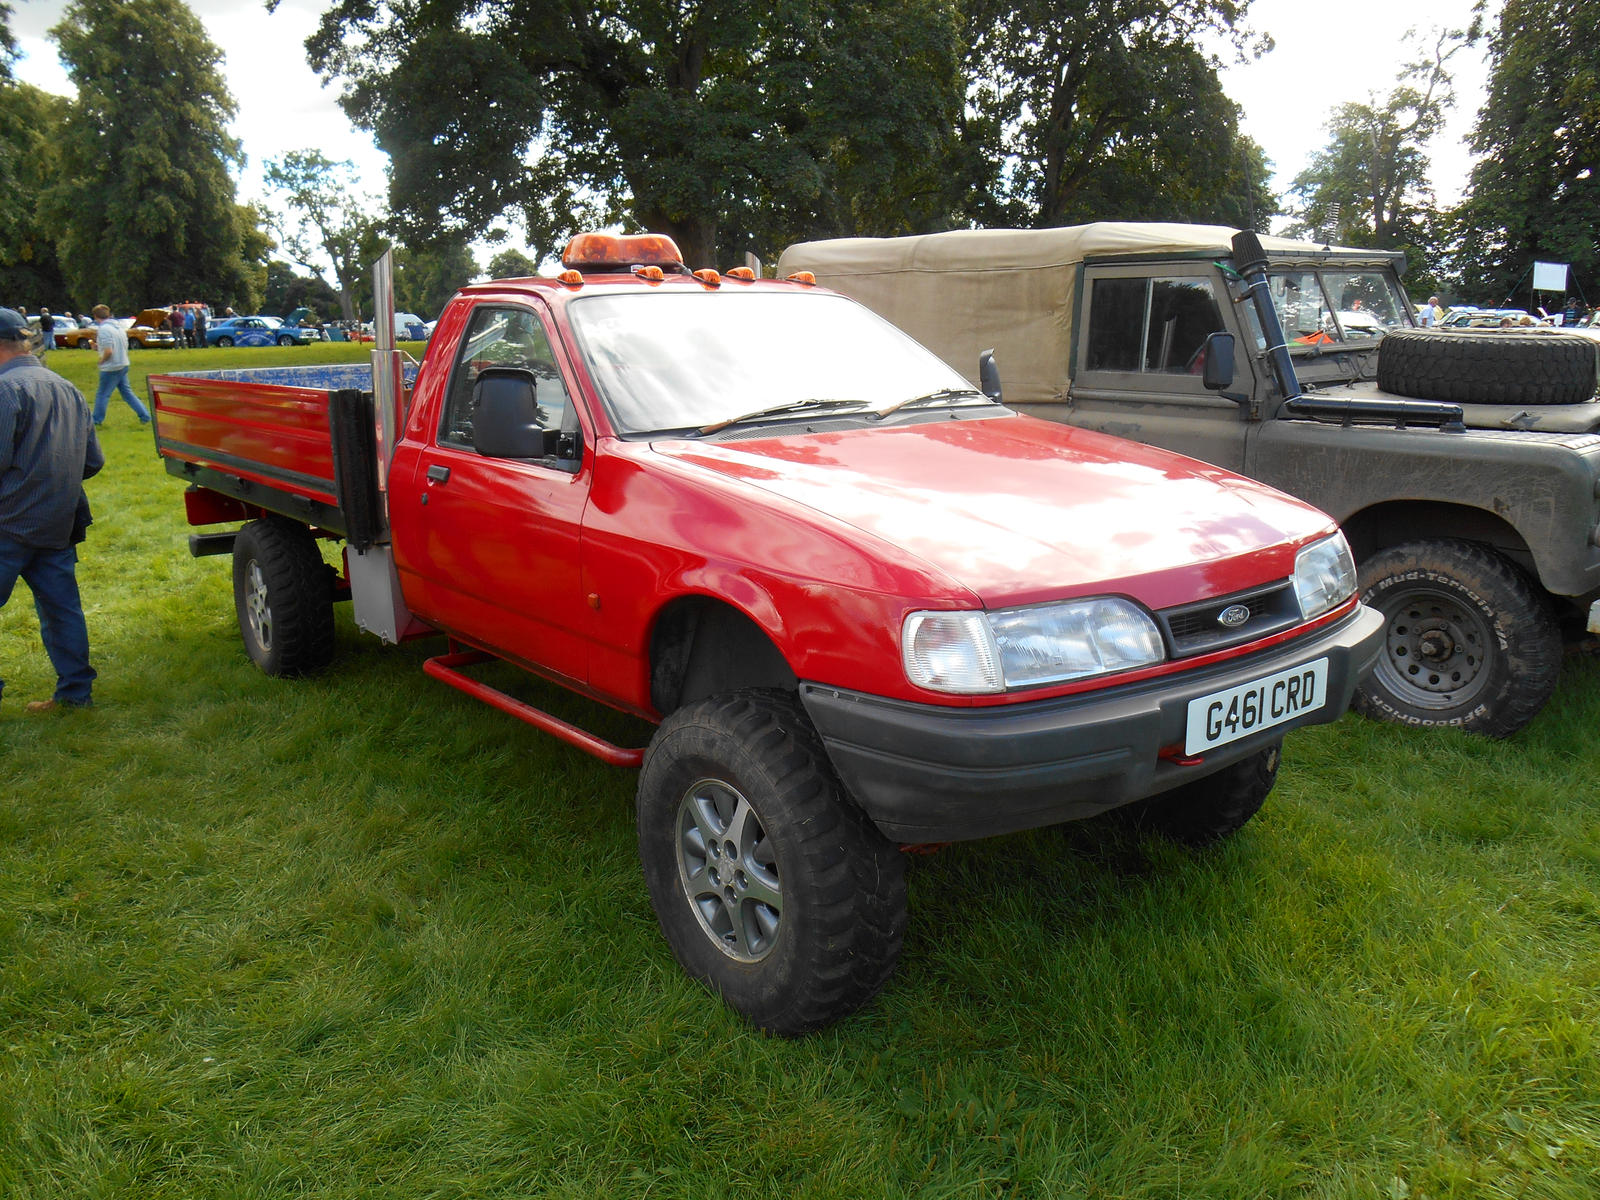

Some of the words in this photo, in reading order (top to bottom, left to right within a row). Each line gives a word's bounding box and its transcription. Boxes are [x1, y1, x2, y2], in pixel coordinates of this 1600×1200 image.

[1379, 571, 1495, 618] Mud-Terrain
[1225, 606, 1246, 624] Ford
[1206, 686, 1265, 742] G461
[1271, 670, 1315, 719] CRD
[1371, 694, 1488, 727] BFGoodrich
